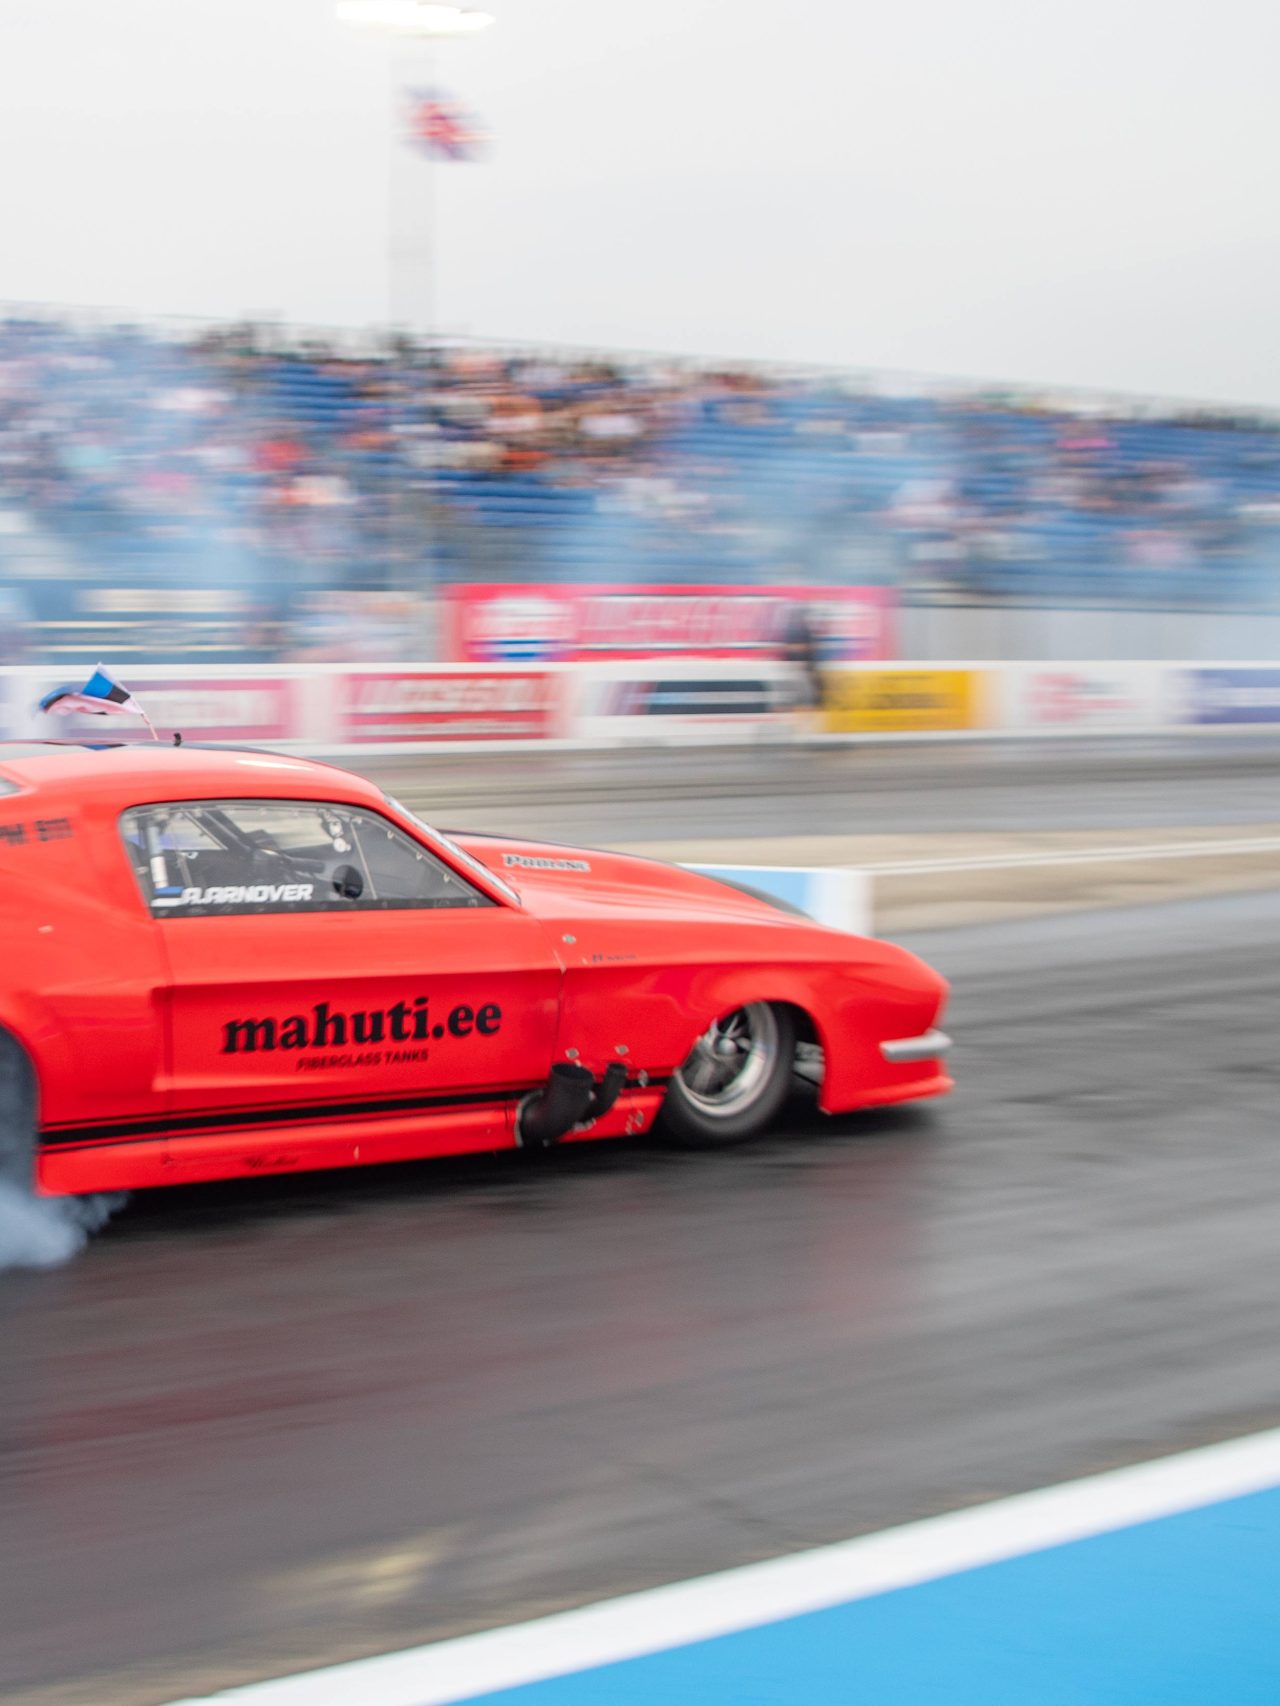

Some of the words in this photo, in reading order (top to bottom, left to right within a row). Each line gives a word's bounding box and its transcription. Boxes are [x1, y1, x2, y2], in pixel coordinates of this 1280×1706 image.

[221, 996, 503, 1054] mahuti.ee
[296, 1051, 382, 1071] FIBERGLASS
[384, 1048, 429, 1066] TANKS
